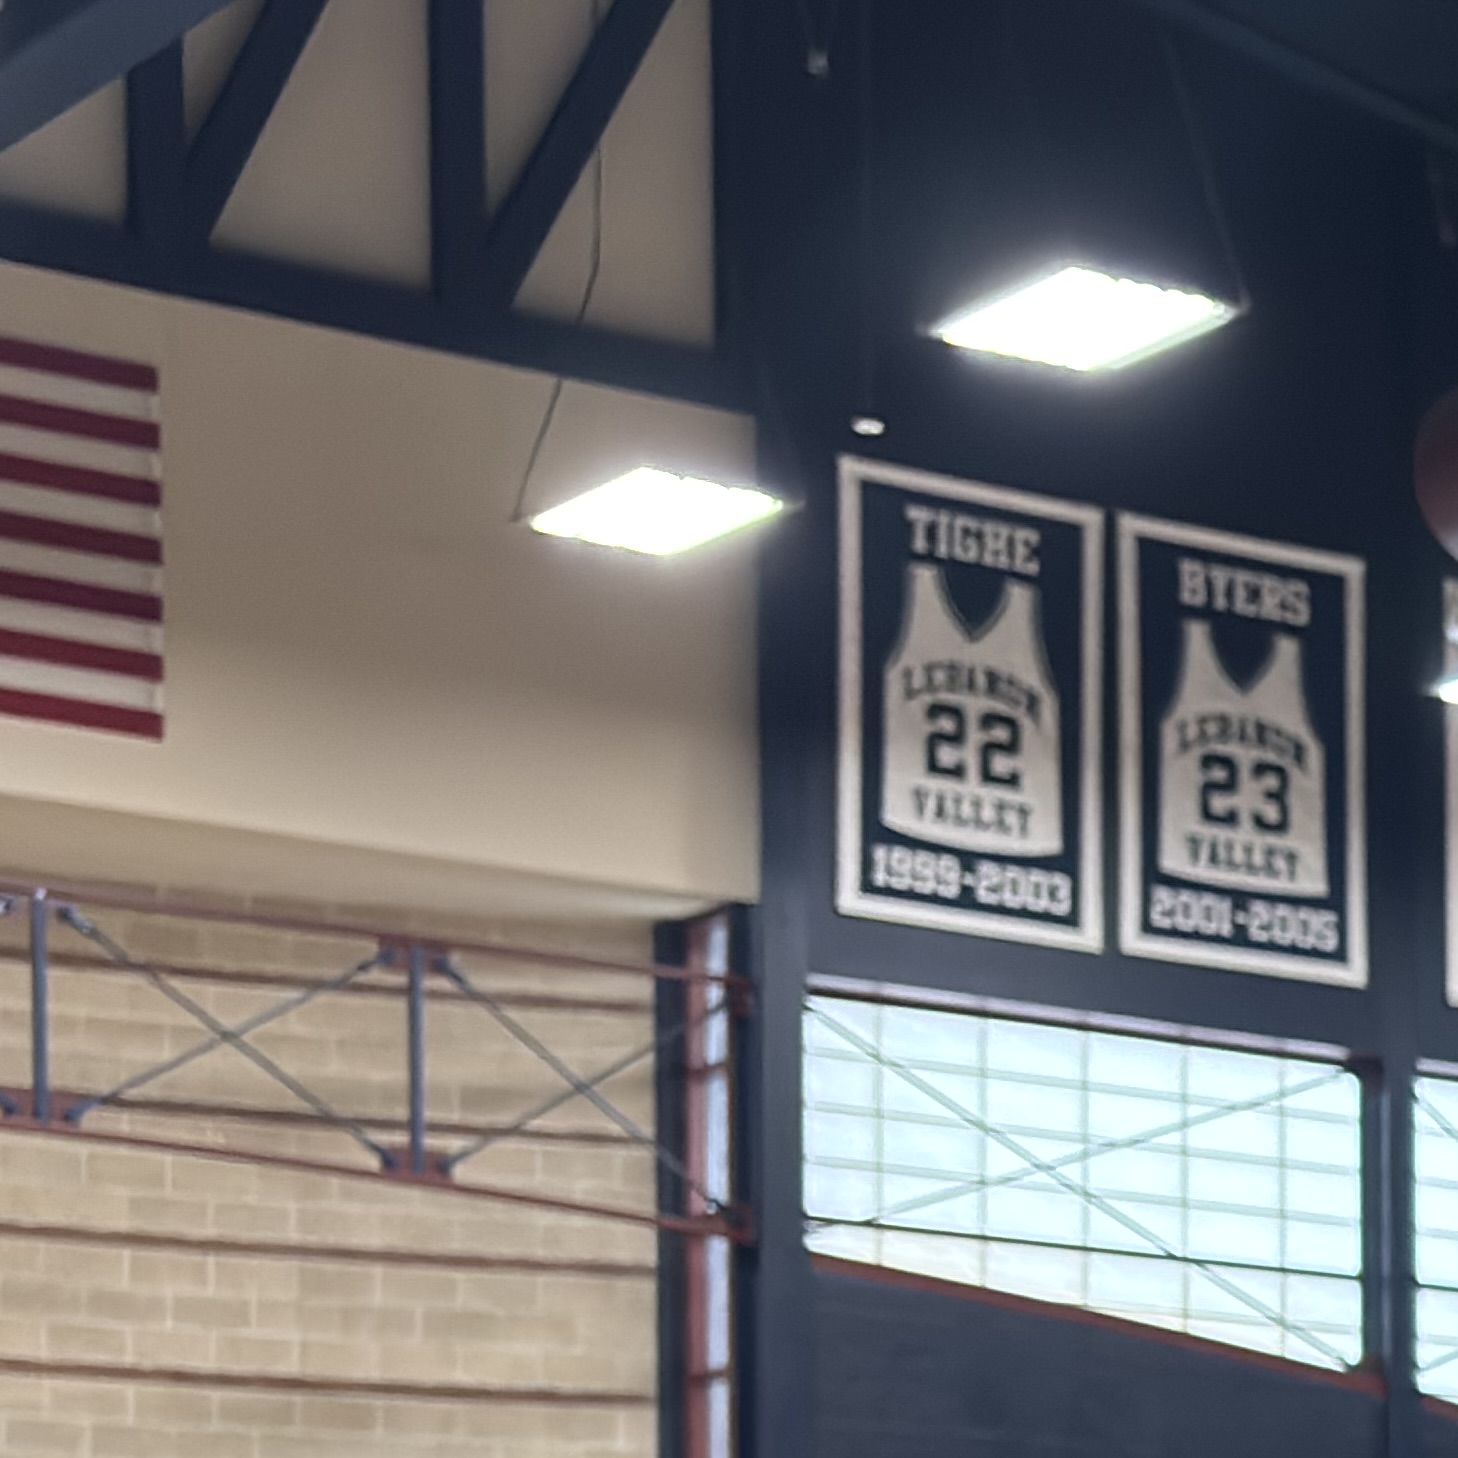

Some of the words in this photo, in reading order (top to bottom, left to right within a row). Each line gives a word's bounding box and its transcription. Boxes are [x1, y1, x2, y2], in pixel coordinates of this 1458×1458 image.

[904, 504, 1041, 577] TIGHE
[1179, 558, 1311, 627] BYERS
[902, 660, 1041, 725] LEBANON
[925, 703, 1021, 786] 22
[1177, 711, 1306, 772] LEBANON
[913, 785, 1030, 839] VALLEY
[1201, 753, 1289, 832] 23
[872, 844, 1072, 916] 1999-2003
[1185, 832, 1298, 882] VALLEY
